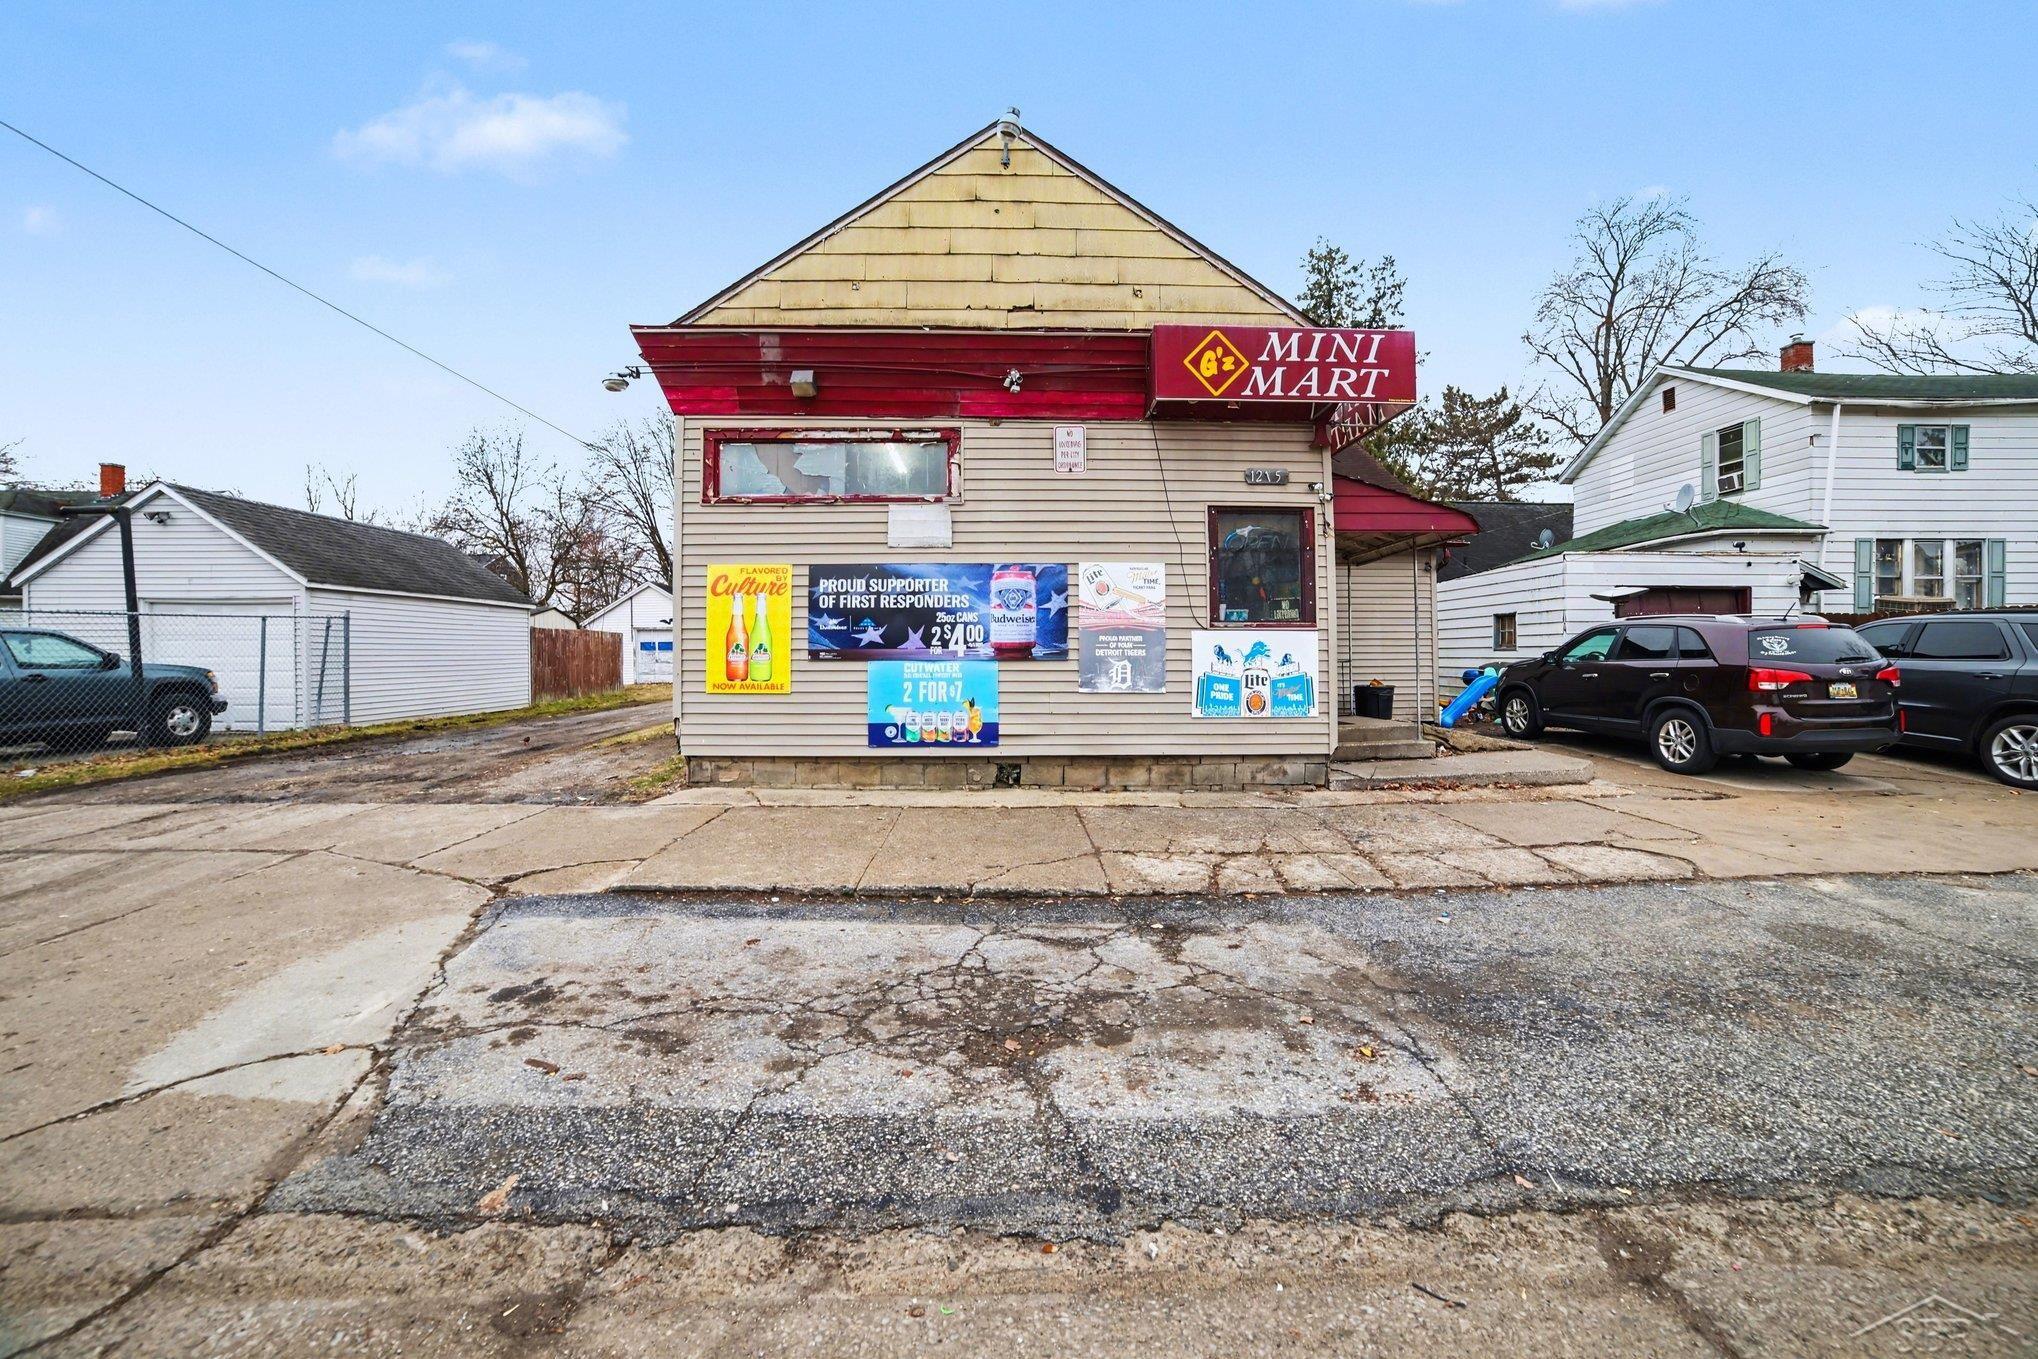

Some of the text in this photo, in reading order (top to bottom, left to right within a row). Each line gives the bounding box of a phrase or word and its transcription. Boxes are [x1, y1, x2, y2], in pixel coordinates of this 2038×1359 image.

[1257, 331, 1385, 364] MINI
[1200, 346, 1235, 378] G'z
[1241, 366, 1390, 398] MART
[1250, 469, 1281, 483] 1215
[740, 567, 789, 575] FLAVORED
[710, 574, 788, 597] Culture
[819, 578, 949, 593] PROUD SUPPORTER
[818, 594, 970, 609] OF FIRST RESPONDERS
[935, 611, 979, 623] 25oz CANS
[931, 626, 942, 646] 2
[930, 646, 943, 655] FOR
[903, 662, 960, 673] CUTWATER
[712, 683, 785, 691] NOW AVAILABLE
[1213, 682, 1230, 692] ONE
[1244, 674, 1268, 690] Lite
[903, 681, 963, 703] 2 FOR $7
[1210, 691, 1234, 702] PRIDE
